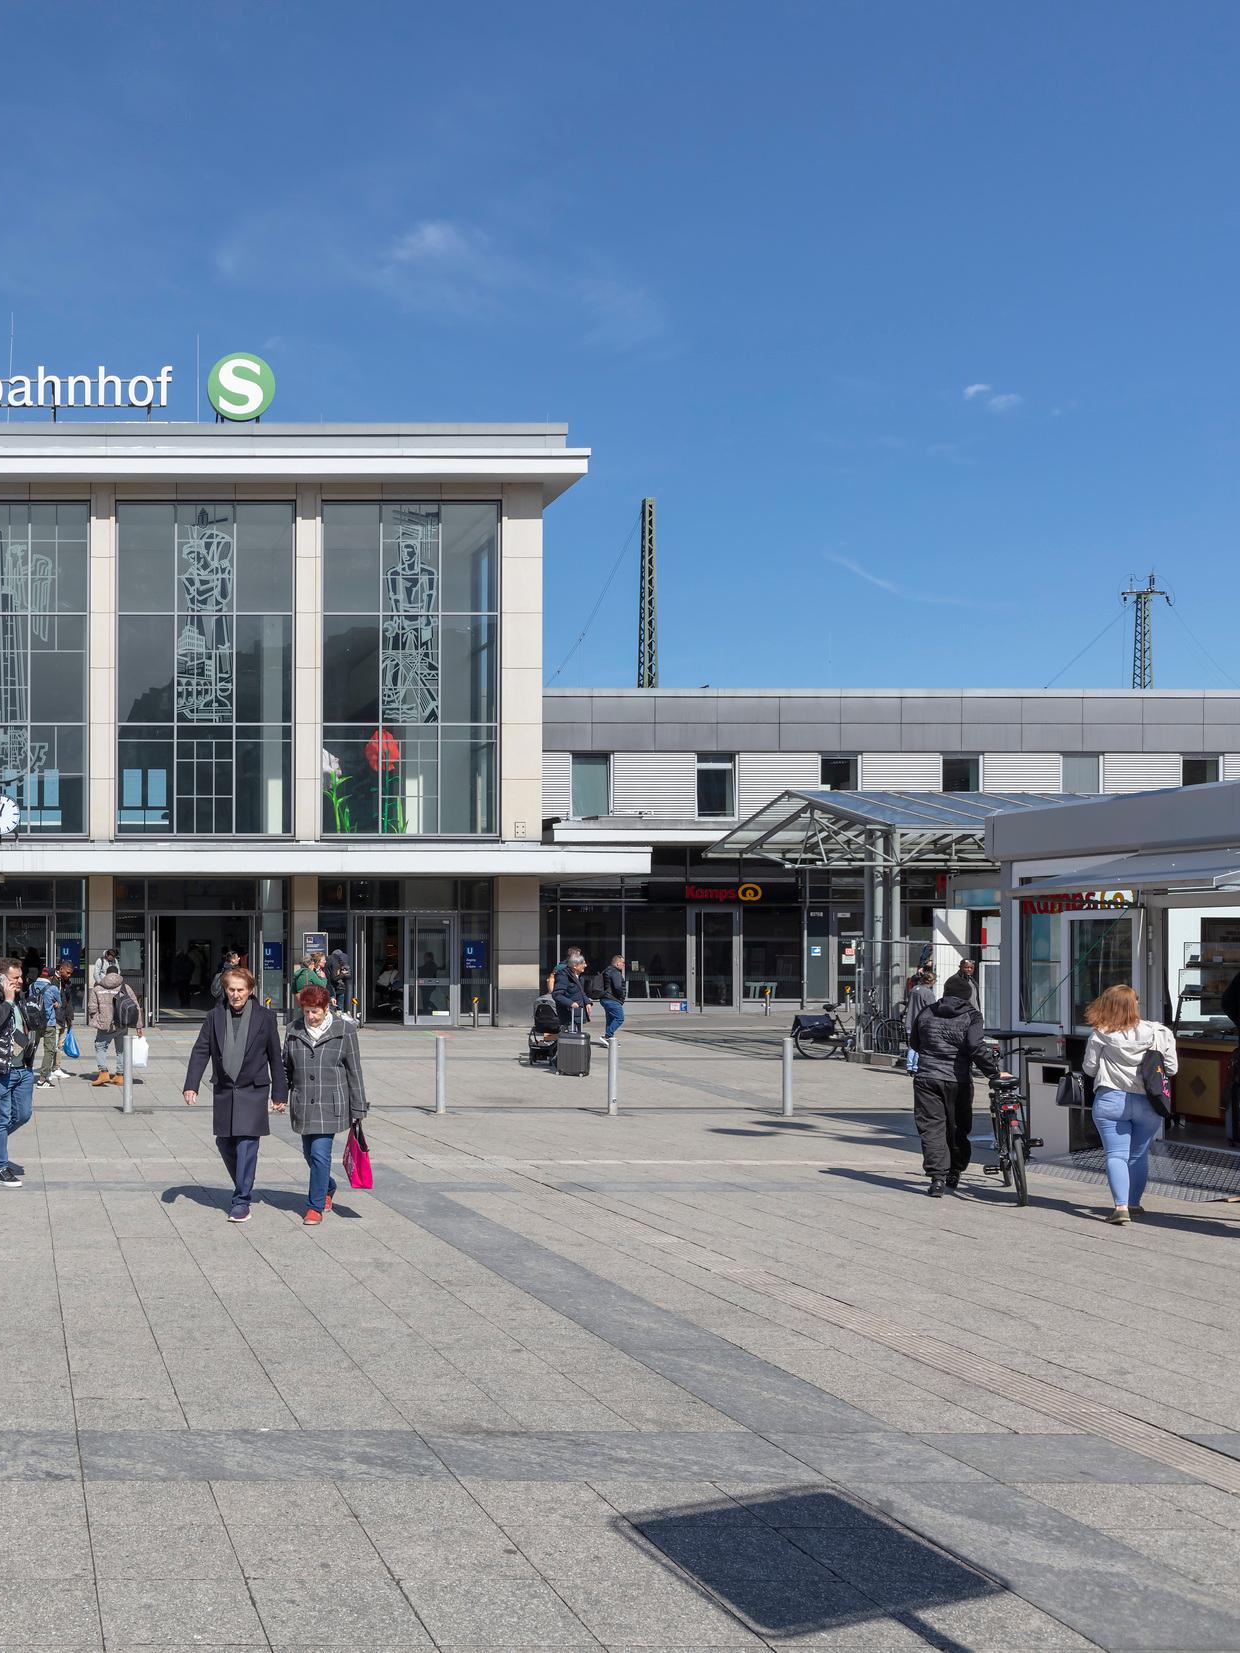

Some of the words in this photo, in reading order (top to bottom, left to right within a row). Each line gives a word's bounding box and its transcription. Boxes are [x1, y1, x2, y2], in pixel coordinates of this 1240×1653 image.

[218, 358, 264, 415] S
[685, 884, 737, 902] Kamps
[265, 948, 271, 956] U
[467, 947, 473, 955] U
